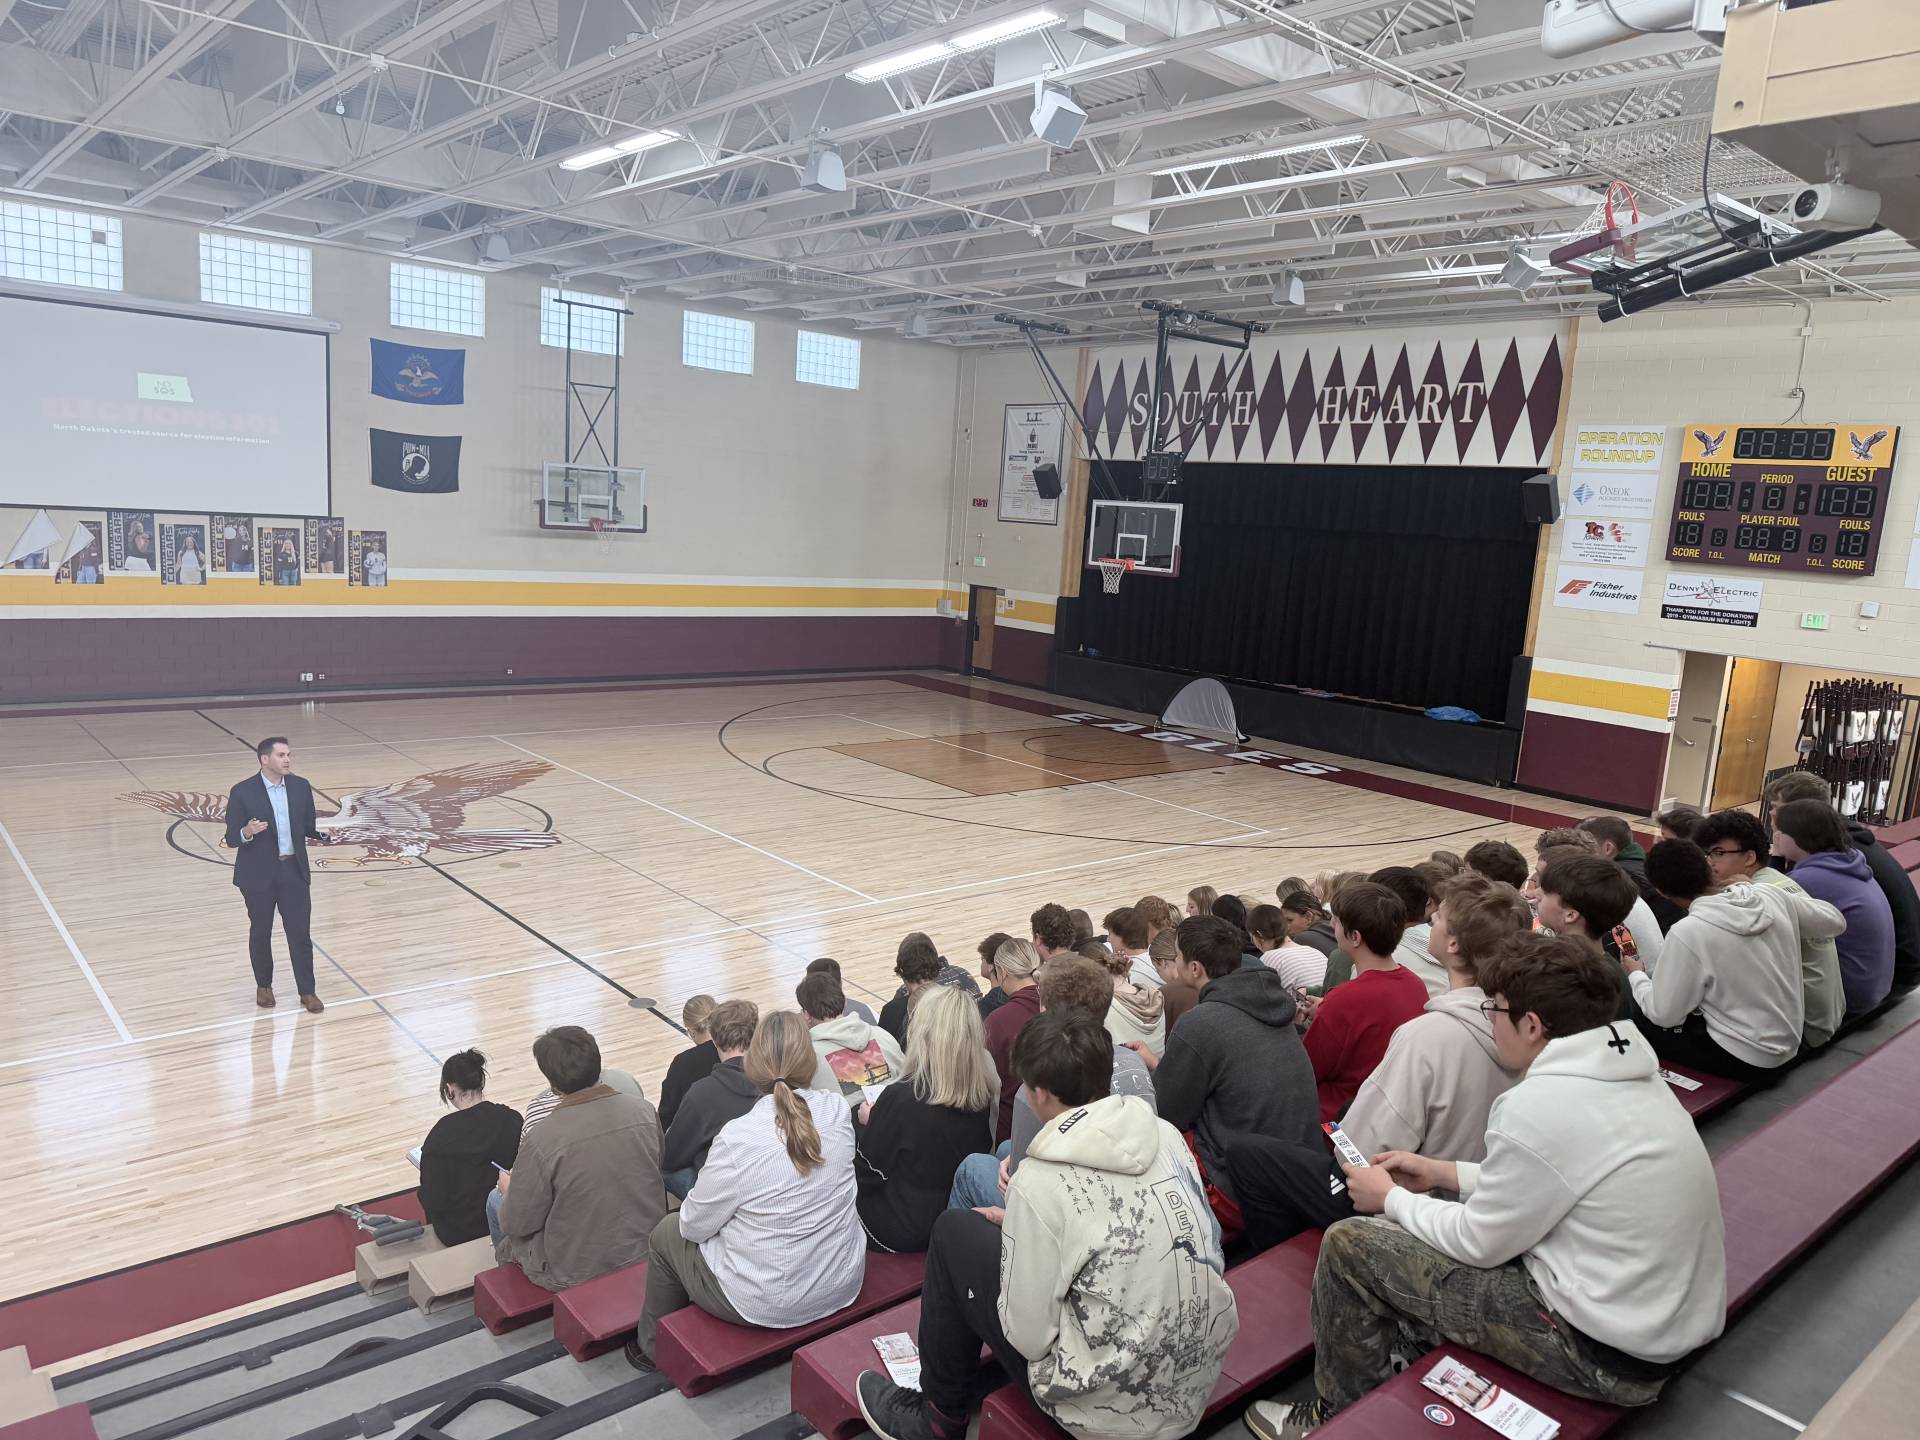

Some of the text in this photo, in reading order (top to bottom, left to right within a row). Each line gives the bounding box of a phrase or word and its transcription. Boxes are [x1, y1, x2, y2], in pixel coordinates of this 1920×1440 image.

[1131, 391, 1255, 426] SOUTH
[1320, 382, 1486, 425] HEART
[1578, 432, 1663, 445] OPERATION
[1581, 449, 1655, 463] ROUNDUP
[1691, 463, 1732, 478] HOME
[1826, 467, 1878, 482] GUEST
[1760, 474, 1794, 485] PERIOD
[1600, 485, 1630, 497] ONEOK
[1679, 511, 1705, 521] FOULS
[1741, 514, 1800, 527] PLAYER FOUL
[1839, 519, 1871, 530] FOULS
[216, 516, 225, 567] EAGLES
[310, 519, 318, 569] EAGLES
[166, 526, 174, 582] COUGARS
[265, 531, 273, 581] EAGLES
[353, 533, 361, 582] EAGLES
[1672, 547, 1701, 558] SCORE
[1708, 551, 1725, 560] T.O.L.
[1748, 552, 1782, 564] MATCH
[1806, 558, 1825, 567] T.O.L.
[1832, 559, 1865, 570] SCORE
[1592, 581, 1624, 591] Fisher
[1669, 582, 1759, 597] DENNY ELECTRIC
[1589, 590, 1638, 601] Industries
[1682, 614, 1716, 622] GYMNASIUM
[1730, 618, 1752, 626] LIGHTS
[1722, 612, 1754, 620] DONATION!
[1806, 614, 1825, 627] EXIT
[1052, 712, 1342, 775] EAGLES
